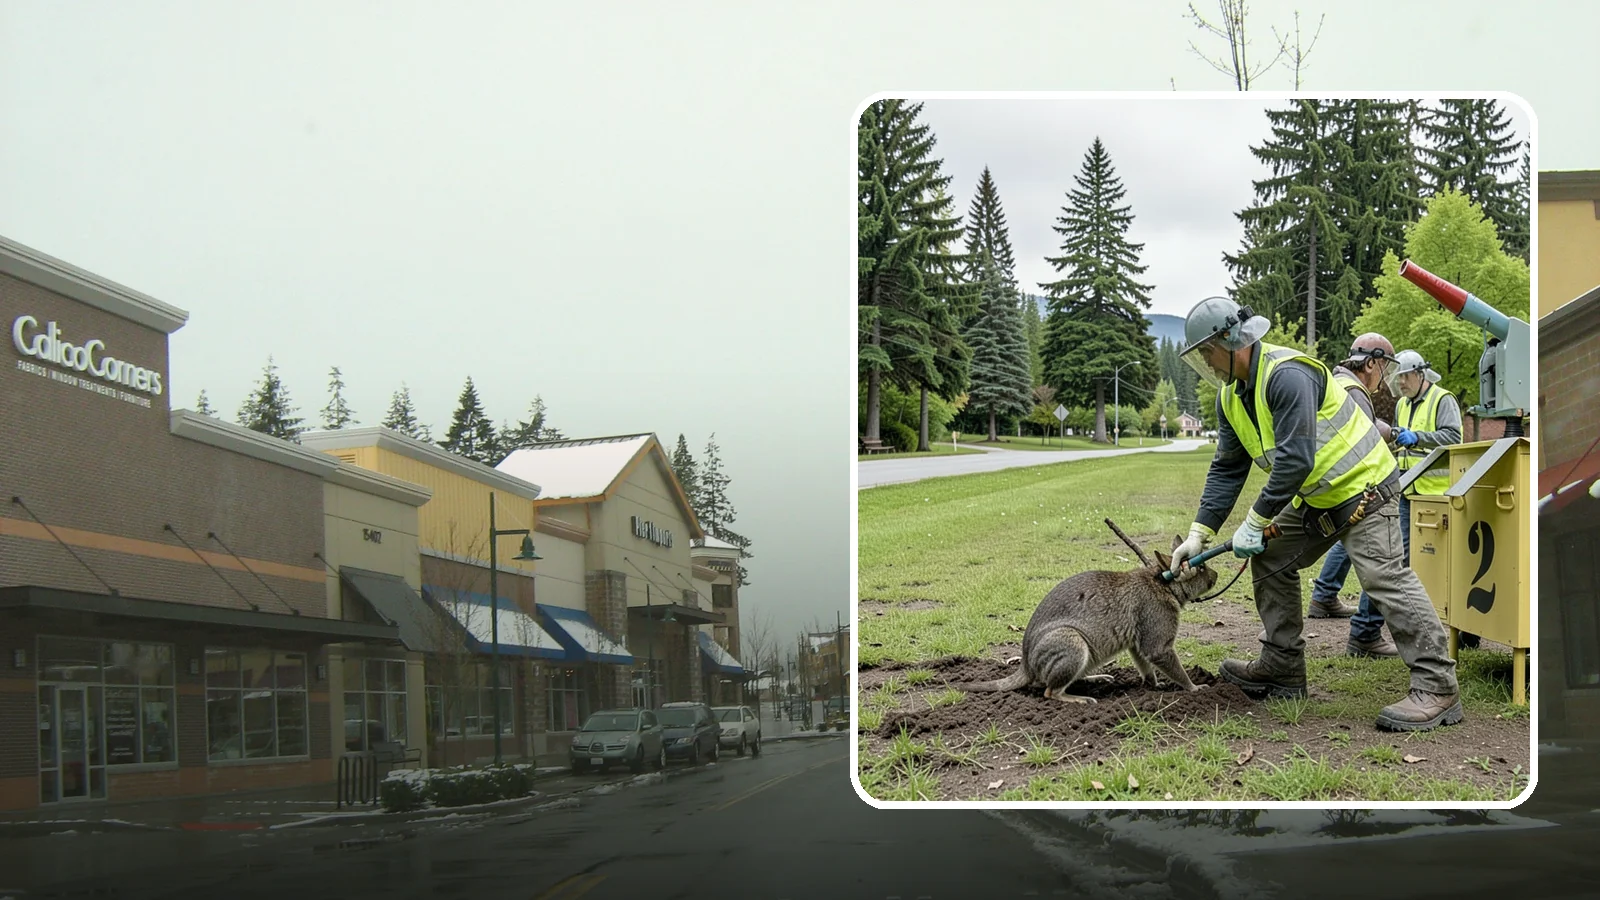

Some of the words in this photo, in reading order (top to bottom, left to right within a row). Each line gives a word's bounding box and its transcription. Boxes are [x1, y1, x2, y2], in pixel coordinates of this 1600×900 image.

[17, 360, 47, 378] FABRICS
[51, 370, 78, 387] WINDOW
[79, 378, 117, 398] TREATMENTS
[120, 391, 151, 409] FURNITURE
[1467, 520, 1496, 614] 2
